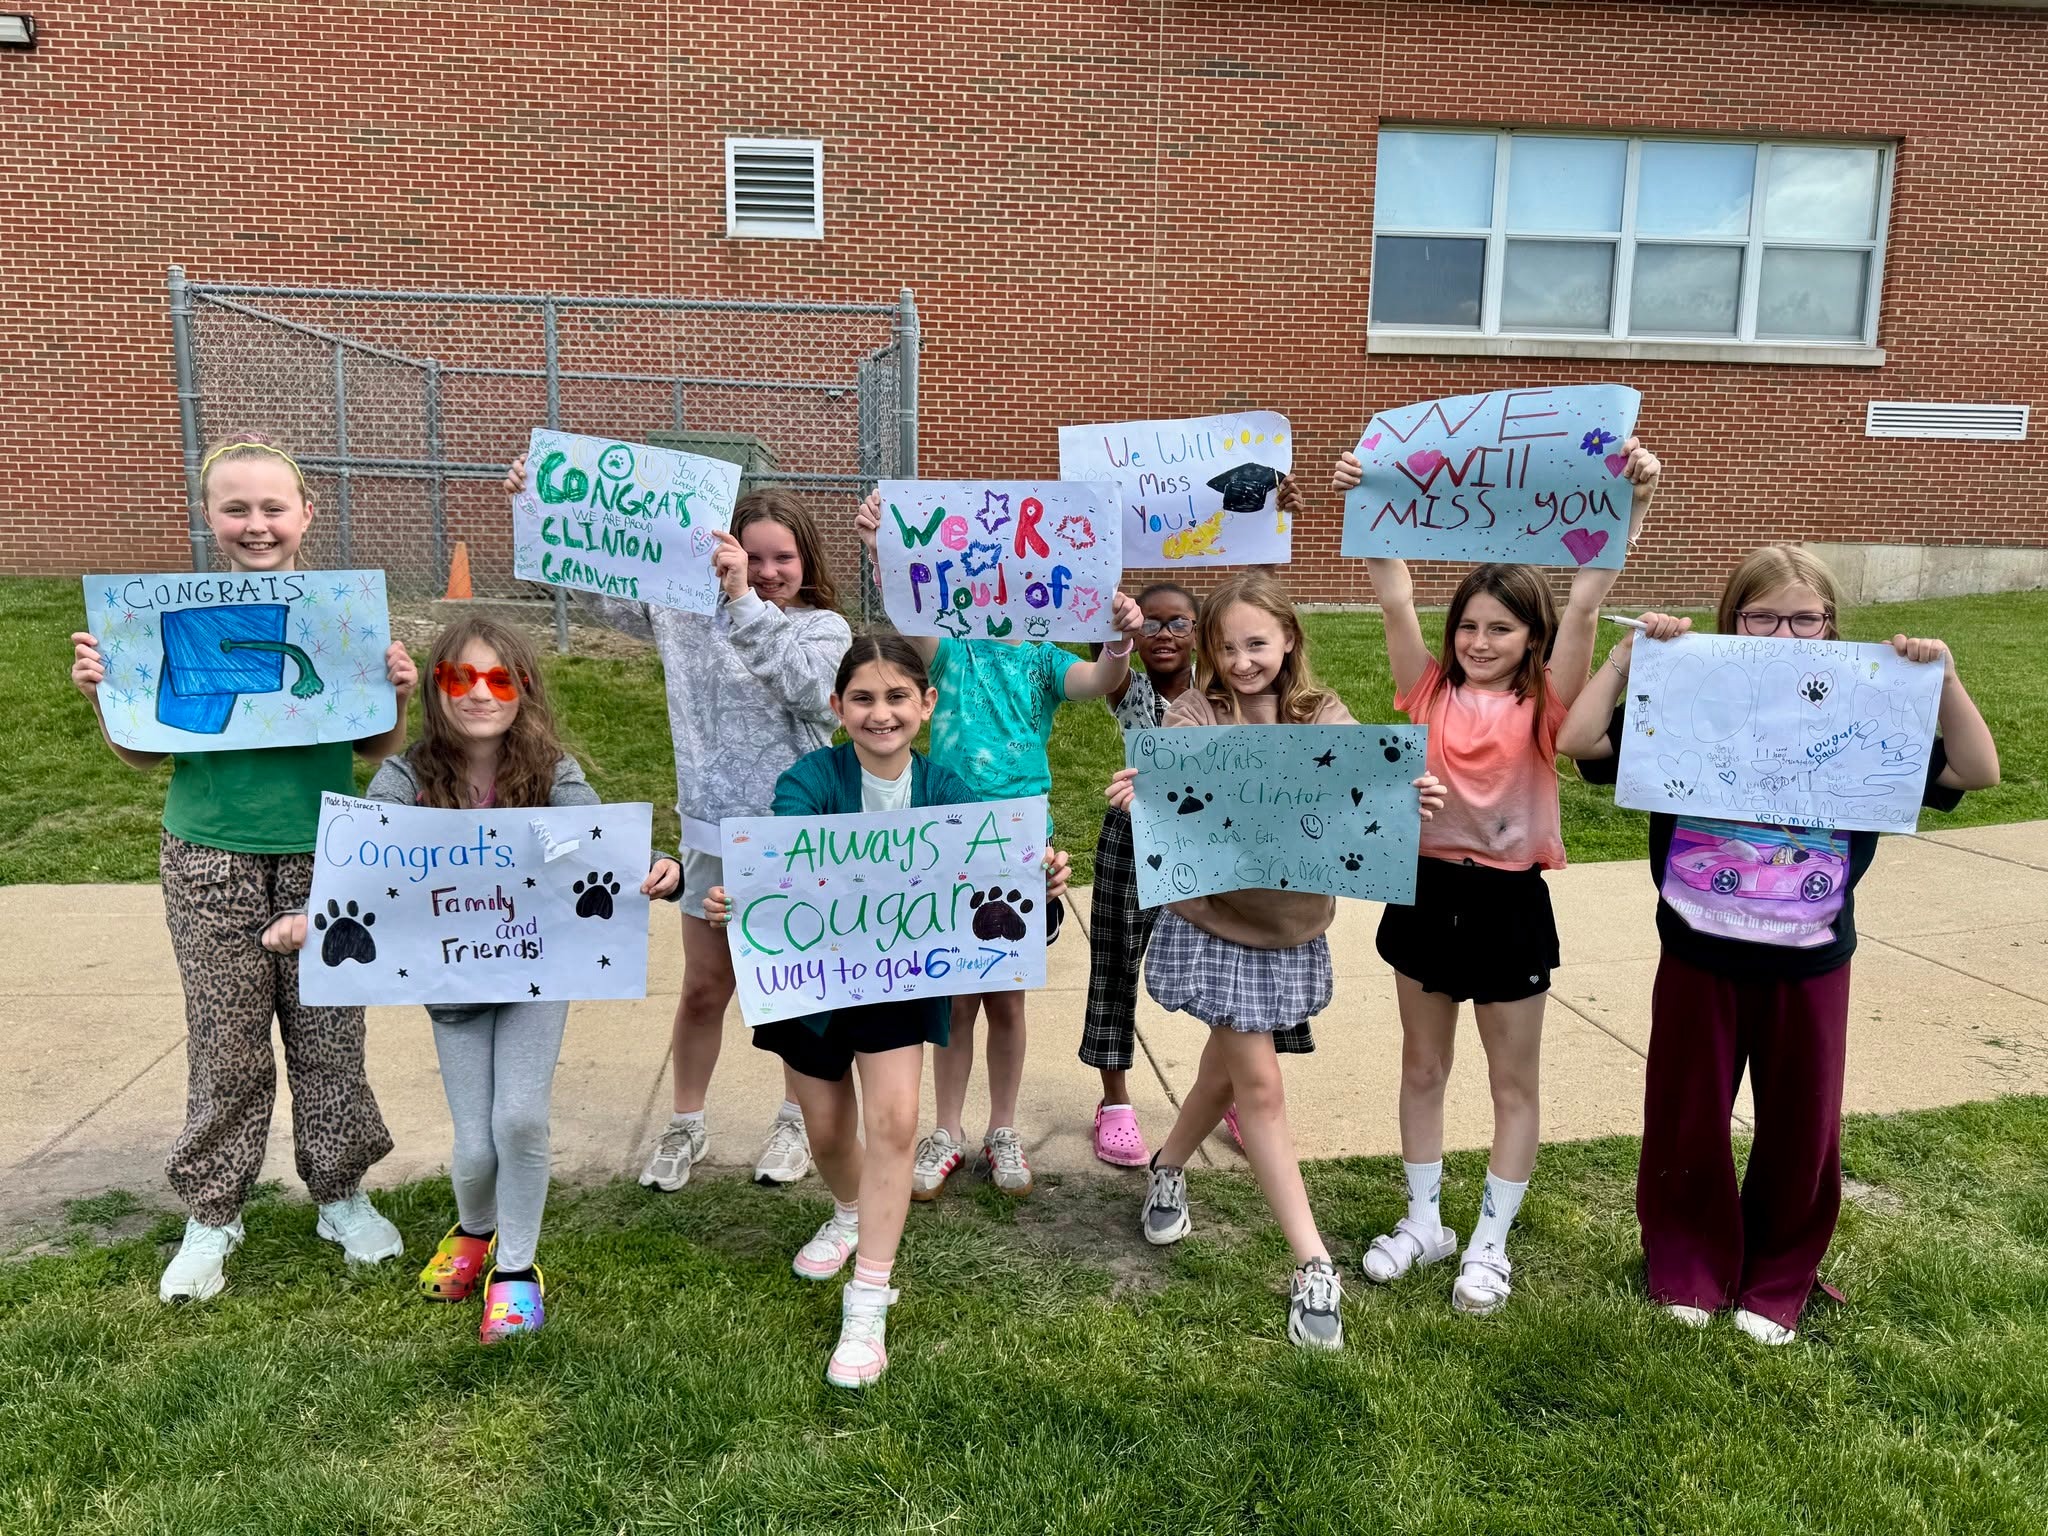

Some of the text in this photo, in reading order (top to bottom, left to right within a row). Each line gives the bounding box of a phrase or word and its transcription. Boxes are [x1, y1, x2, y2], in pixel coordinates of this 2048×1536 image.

[1376, 390, 1568, 444] WE
[1104, 431, 1216, 468] We Will
[572, 507, 653, 533] WE ARE PROUD
[1013, 496, 1051, 559] R
[1370, 490, 1496, 532] MISS
[541, 515, 662, 563] CLINTON
[123, 574, 305, 610] CONGRATS
[1024, 564, 1073, 610] of
[964, 810, 1012, 864] A
[431, 884, 515, 922] Family
[741, 882, 976, 956] Cougar
[496, 916, 537, 940] and
[1762, 918, 1798, 935] super
[441, 936, 543, 964] Friends!
[832, 957, 867, 984] to
